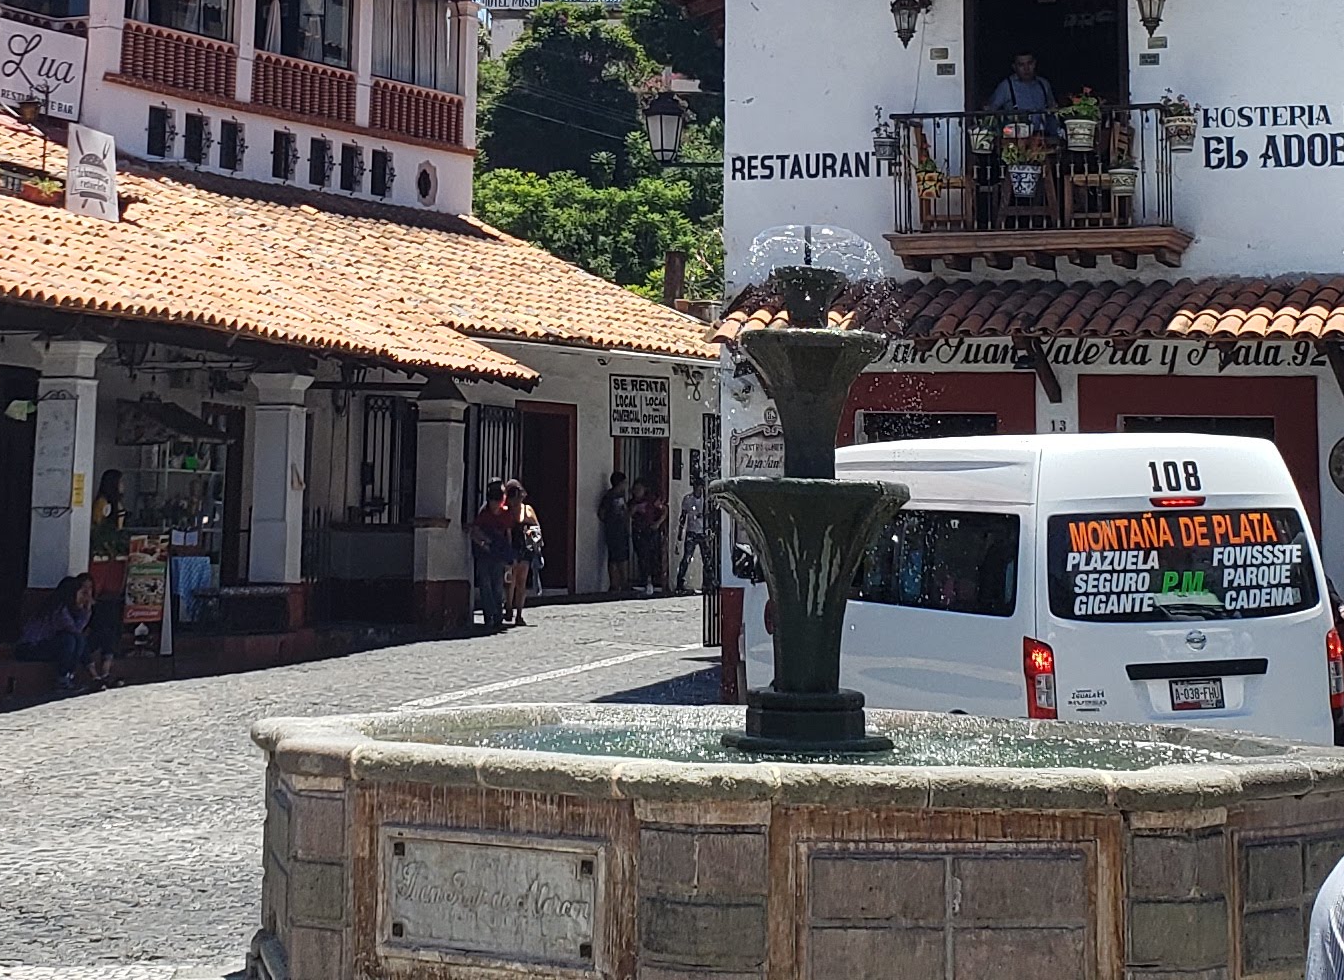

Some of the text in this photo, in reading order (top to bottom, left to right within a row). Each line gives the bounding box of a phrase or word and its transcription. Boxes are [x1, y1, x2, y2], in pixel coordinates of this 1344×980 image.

[2, 33, 75, 94] Lua
[1203, 105, 1332, 129] HOSTERIA
[1202, 134, 1248, 170] EL
[1160, 345, 1178, 375] y
[613, 378, 668, 393] SE RENTA
[615, 394, 638, 408] LOCAL
[645, 396, 667, 407] LOCAL
[1051, 419, 1067, 432] 13
[1148, 461, 1203, 493] 108
[1068, 512, 1278, 553] MONTAÑA DE PLATA
[1066, 549, 1160, 572] PLAZUELA
[1212, 543, 1303, 567] FOVISSSTE
[1073, 571, 1151, 594] SEGURO
[1161, 570, 1208, 596] P.M.
[1222, 563, 1292, 589] PARQUE
[1073, 592, 1154, 616] GIGANTE
[1224, 586, 1294, 611] CADENA
[1175, 686, 1221, 701] A-038-FHU
